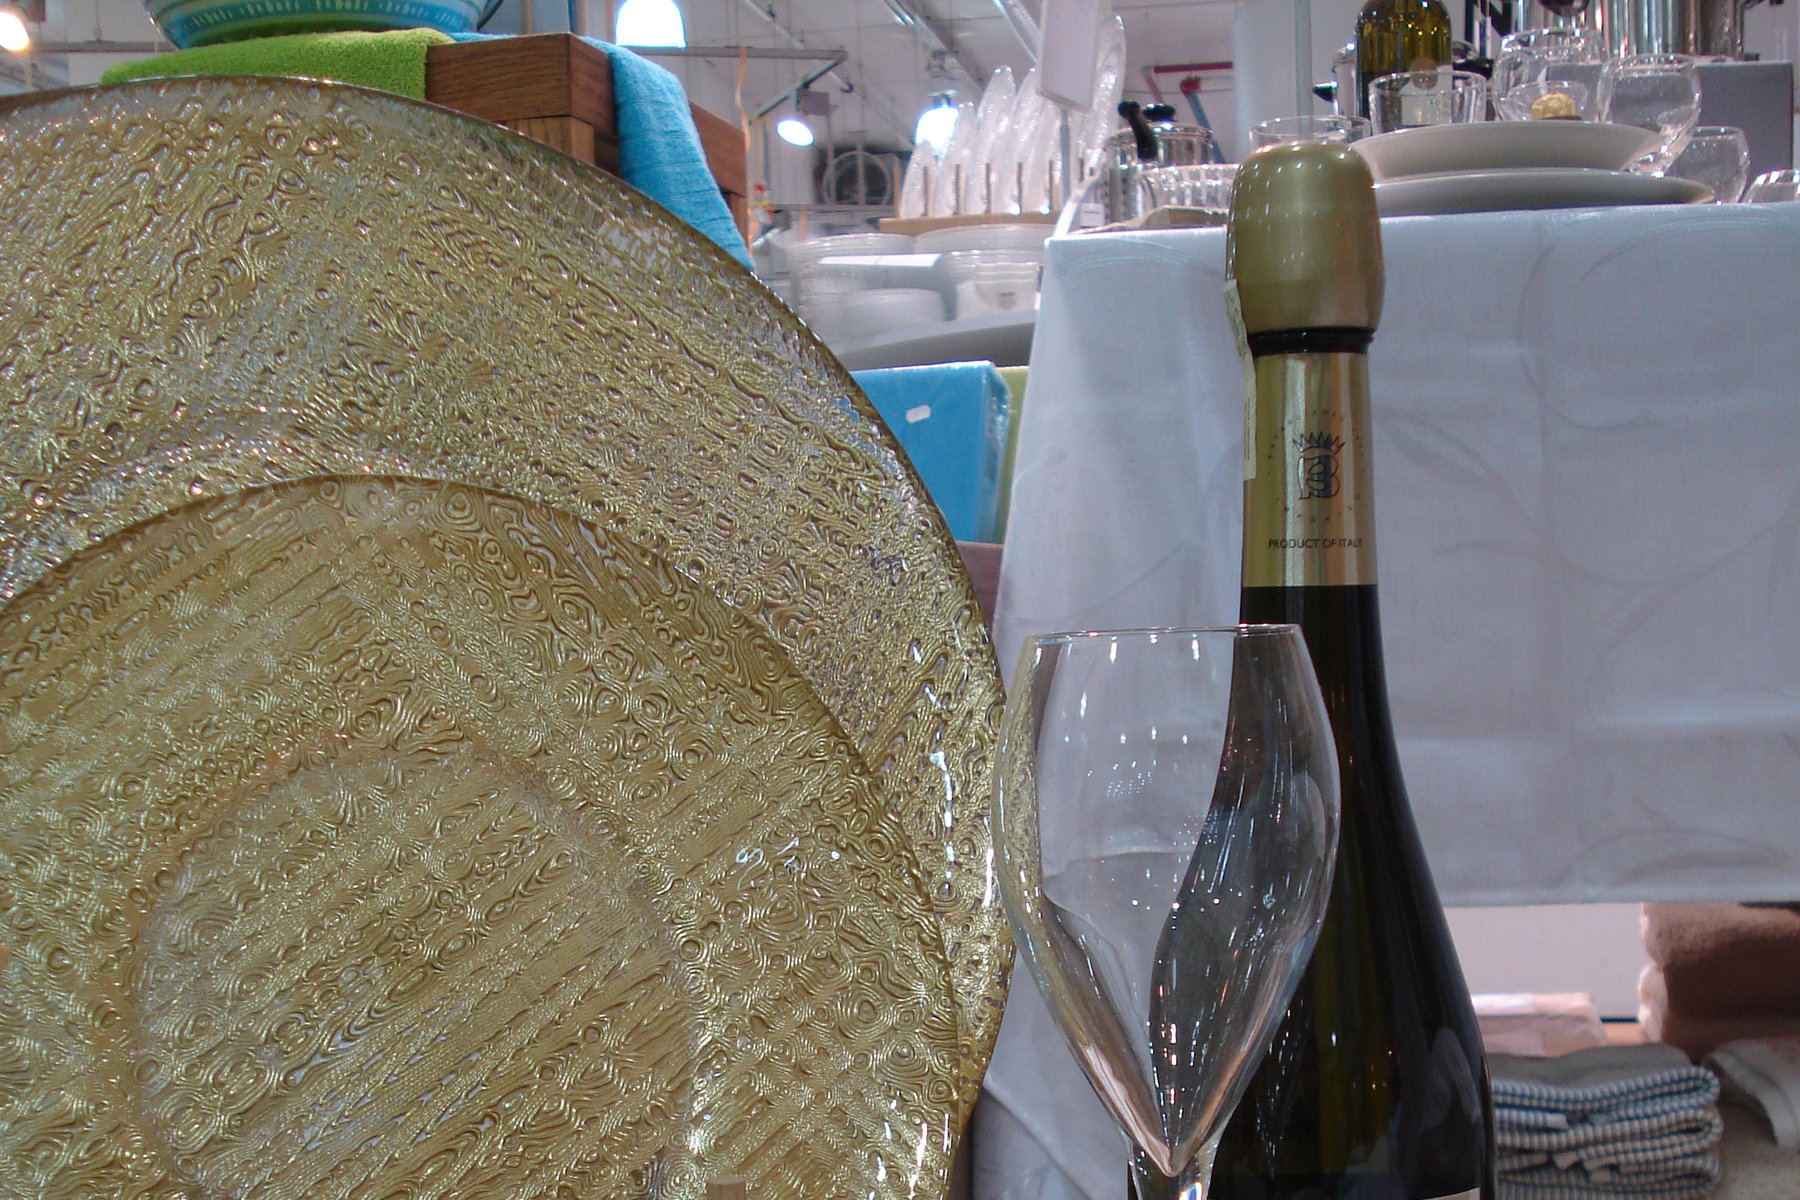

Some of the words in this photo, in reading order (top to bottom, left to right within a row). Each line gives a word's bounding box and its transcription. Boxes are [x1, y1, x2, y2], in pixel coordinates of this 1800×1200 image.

[1268, 538, 1321, 549] PRODUCT
[1322, 538, 1338, 548] OF
[1339, 538, 1363, 548] ITALY
